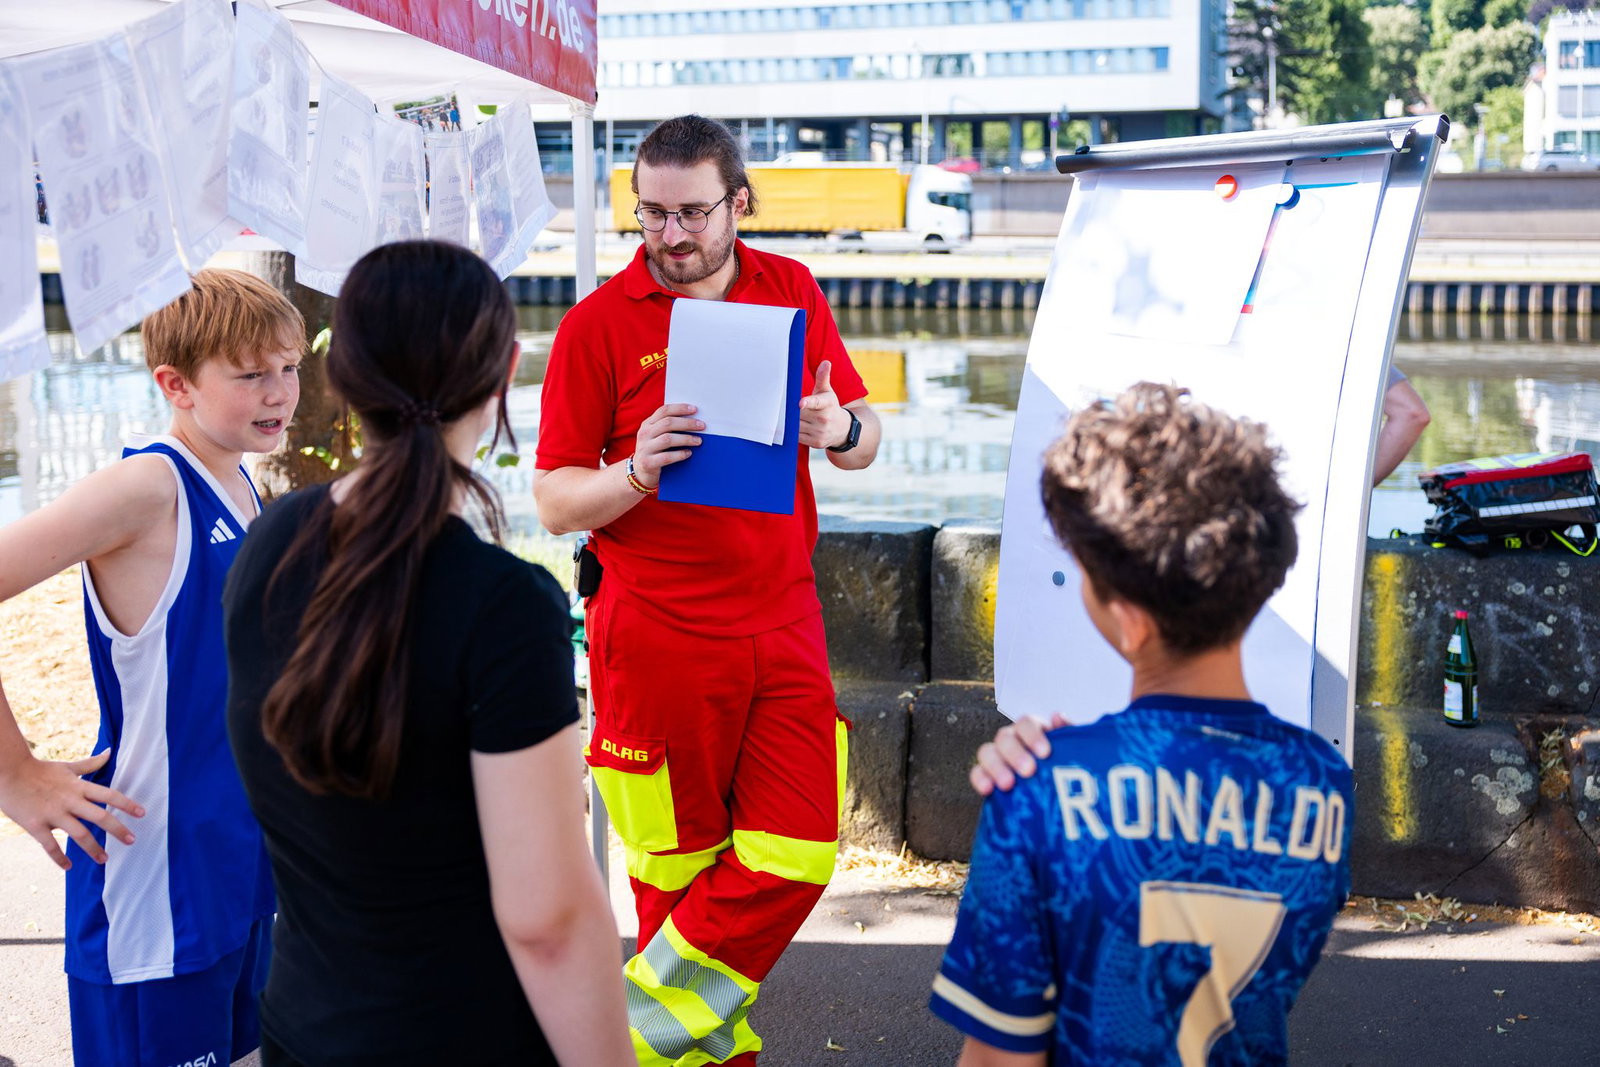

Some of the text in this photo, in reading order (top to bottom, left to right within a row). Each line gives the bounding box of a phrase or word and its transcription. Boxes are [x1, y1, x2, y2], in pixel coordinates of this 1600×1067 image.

[601, 738, 649, 762] DLRG
[1052, 763, 1346, 864] RONALDO
[1138, 879, 1289, 1067] 7
